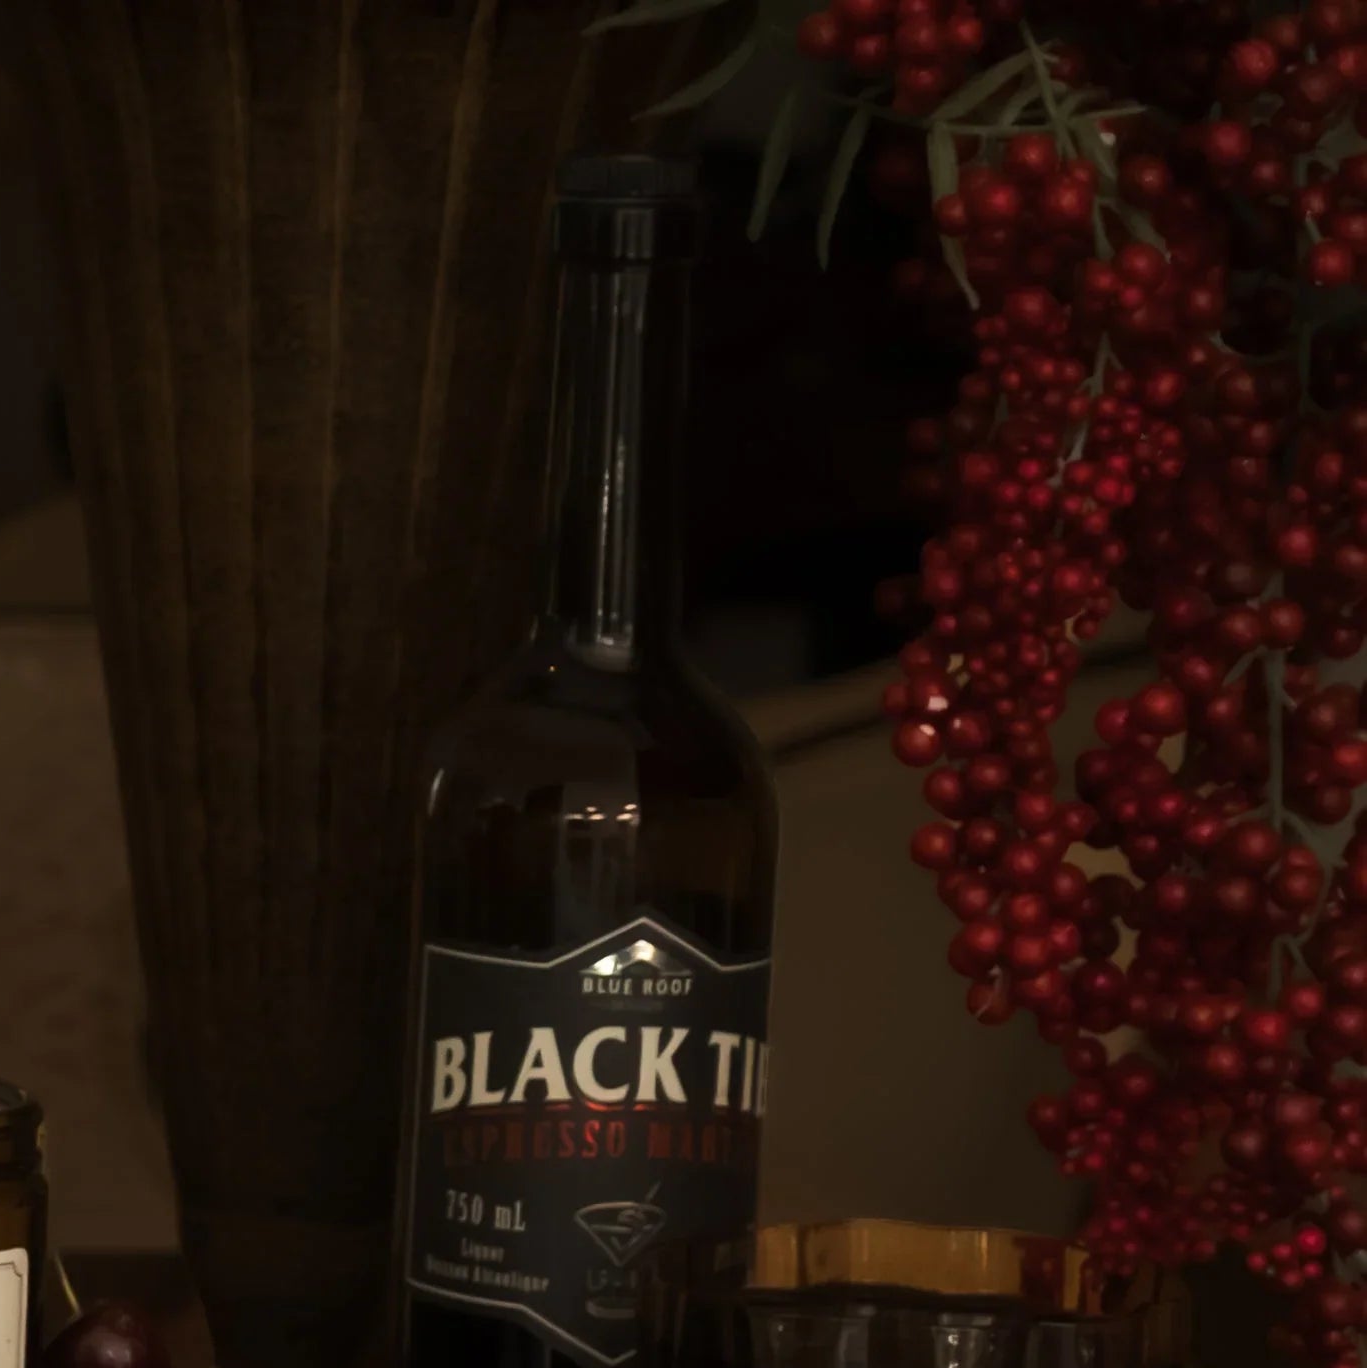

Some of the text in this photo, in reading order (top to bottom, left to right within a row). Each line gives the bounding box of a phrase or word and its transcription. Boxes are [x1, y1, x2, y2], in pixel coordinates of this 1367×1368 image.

[581, 975, 694, 996] BLUE ROOF
[430, 1025, 690, 1115] BLACK
[443, 1118, 627, 1166] ESPRESSO
[445, 1188, 526, 1232] 750 mL
